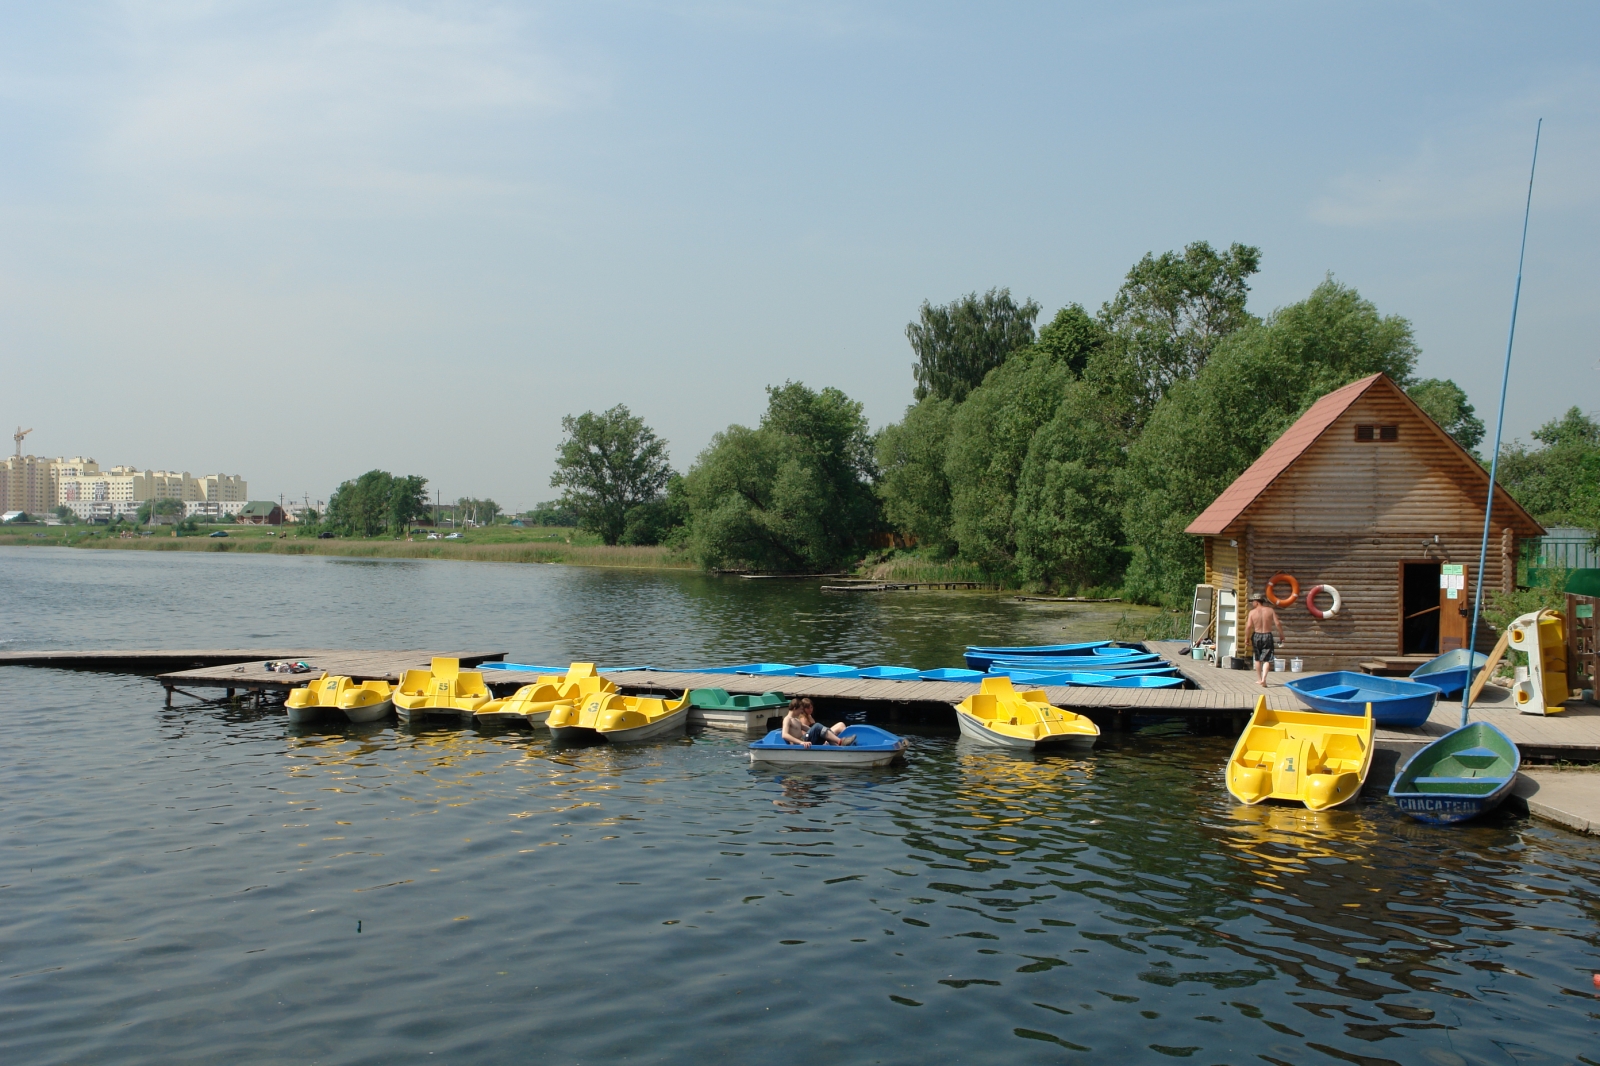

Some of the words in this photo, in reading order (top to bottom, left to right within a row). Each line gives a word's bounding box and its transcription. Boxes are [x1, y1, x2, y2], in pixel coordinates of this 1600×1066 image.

[326, 680, 337, 690] 2
[588, 702, 600, 712] 3
[1284, 757, 1295, 772] 1
